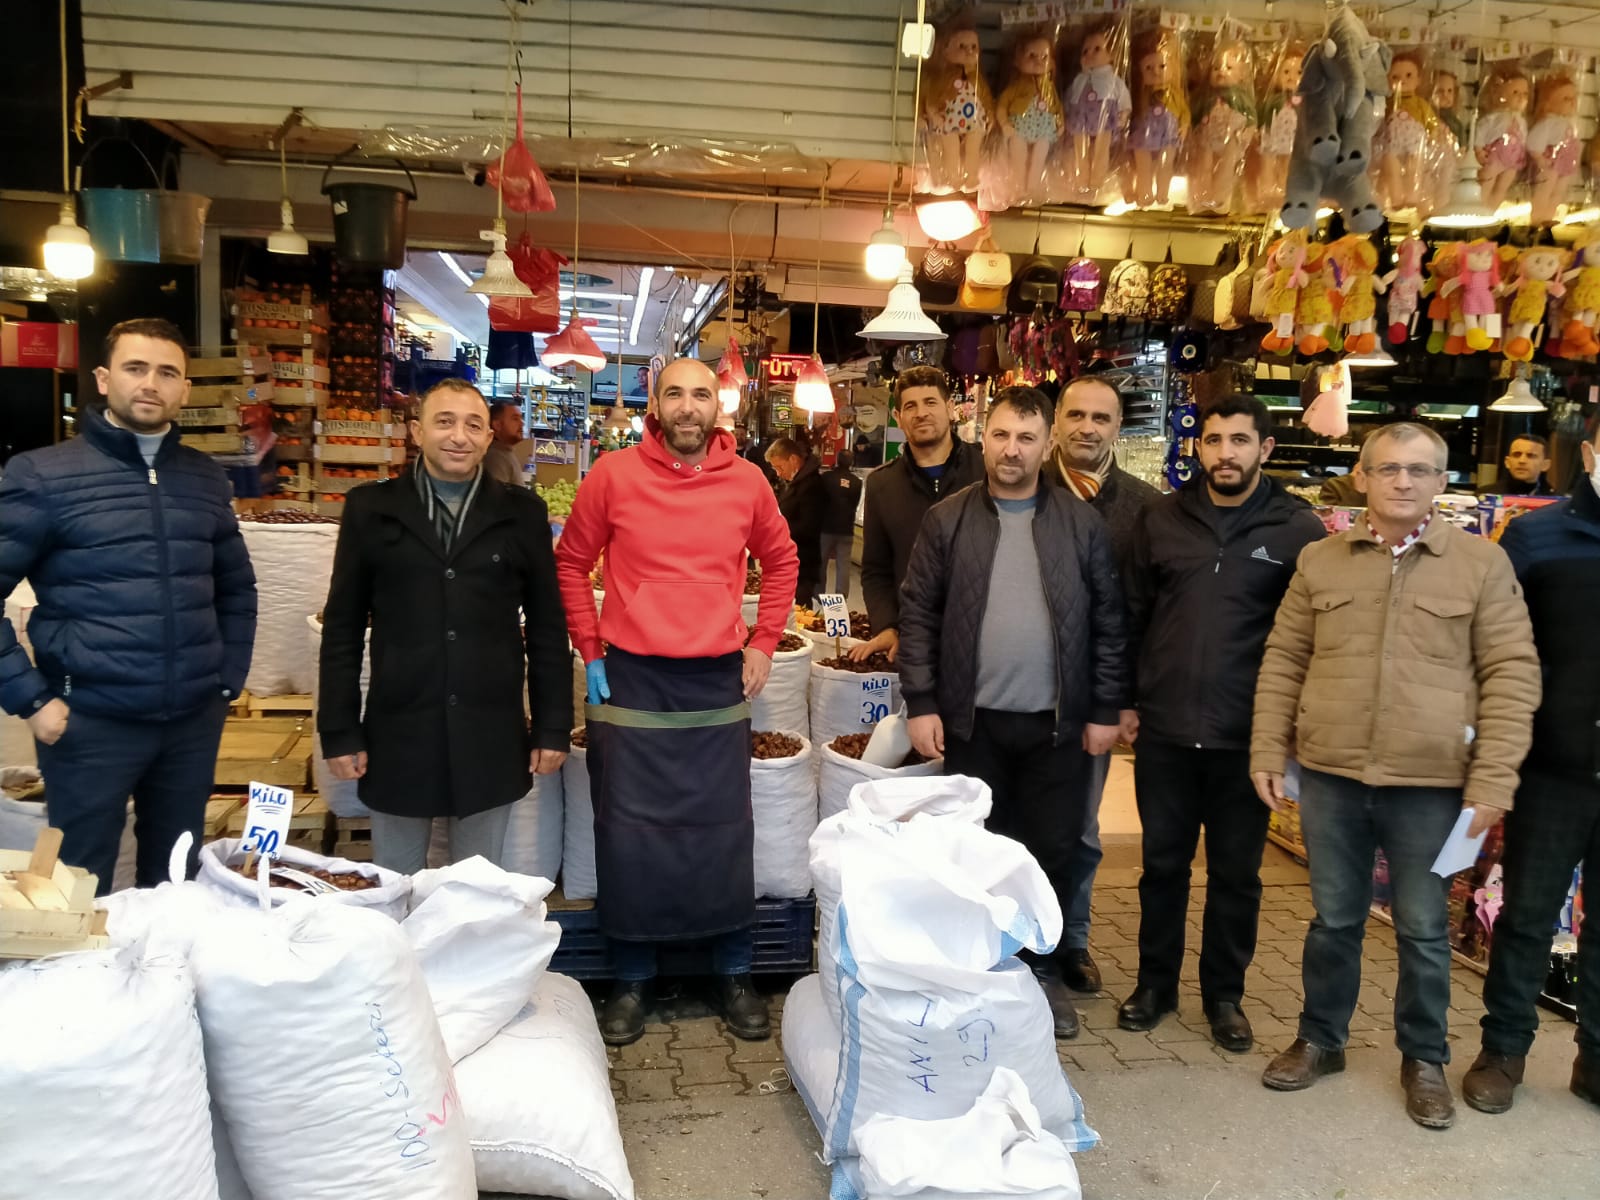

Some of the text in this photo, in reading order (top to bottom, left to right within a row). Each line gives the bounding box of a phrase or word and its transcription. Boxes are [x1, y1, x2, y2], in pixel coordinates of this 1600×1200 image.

[827, 618, 848, 637] 35
[861, 701, 889, 724] 30
[242, 826, 279, 854] 50
